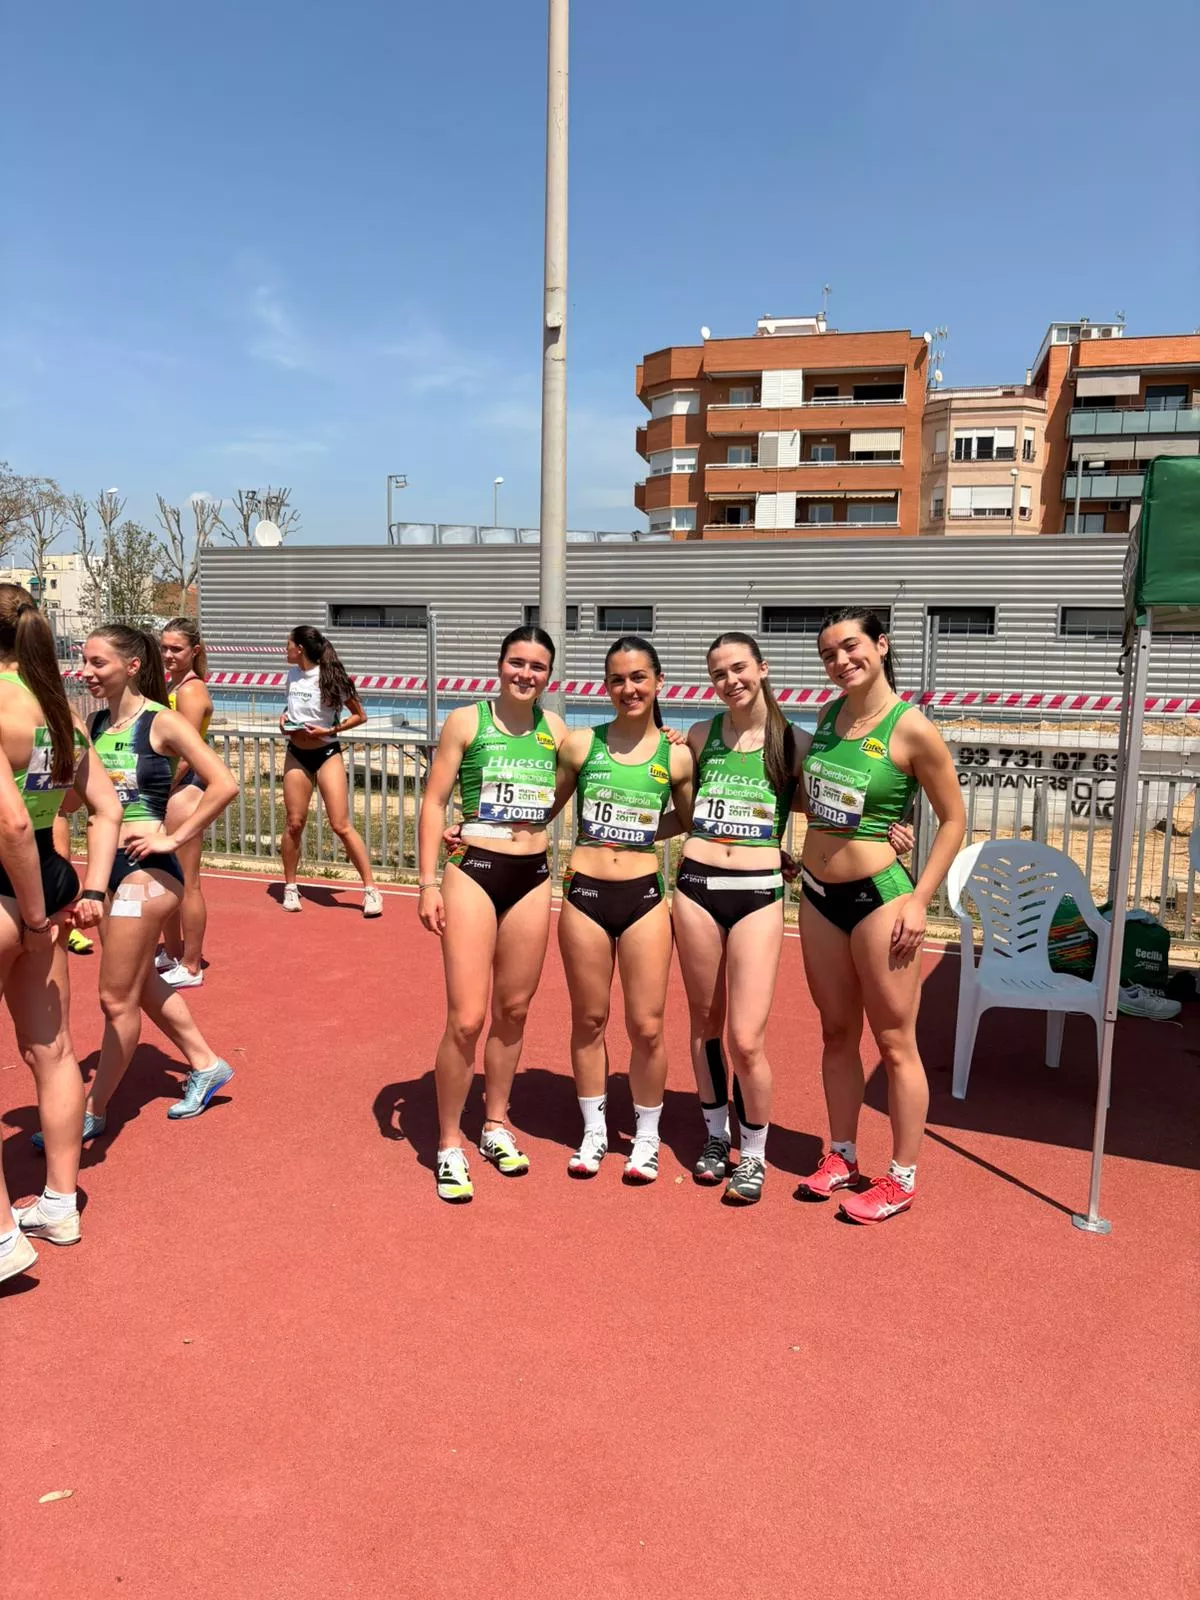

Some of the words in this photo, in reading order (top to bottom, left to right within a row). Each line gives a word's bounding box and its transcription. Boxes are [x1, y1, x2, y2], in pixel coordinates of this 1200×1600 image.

[488, 756, 554, 770] Huesca
[959, 748, 990, 766] 93
[999, 749, 1043, 768] 731
[1053, 752, 1087, 770] 07
[705, 770, 770, 790] Huesca
[808, 776, 821, 799] 15
[495, 783, 515, 804] 15
[594, 801, 613, 824] 16
[707, 798, 725, 820] 16
